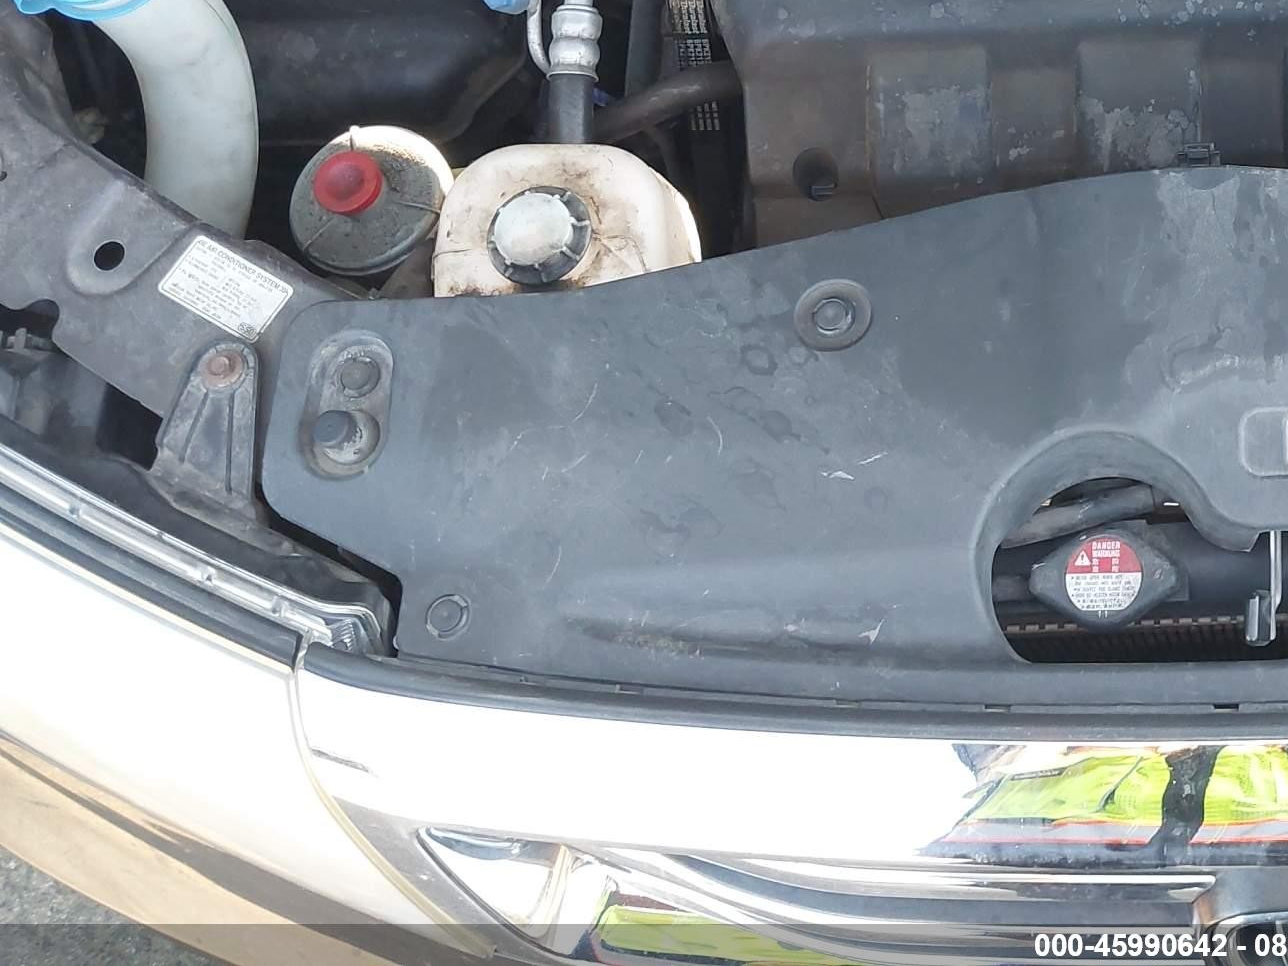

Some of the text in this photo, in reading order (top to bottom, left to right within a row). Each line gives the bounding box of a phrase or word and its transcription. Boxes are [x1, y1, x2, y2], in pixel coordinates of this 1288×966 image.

[217, 249, 257, 275] CONDITIONER
[255, 272, 281, 290] SYSTEM
[1091, 541, 1121, 550] DANGER
